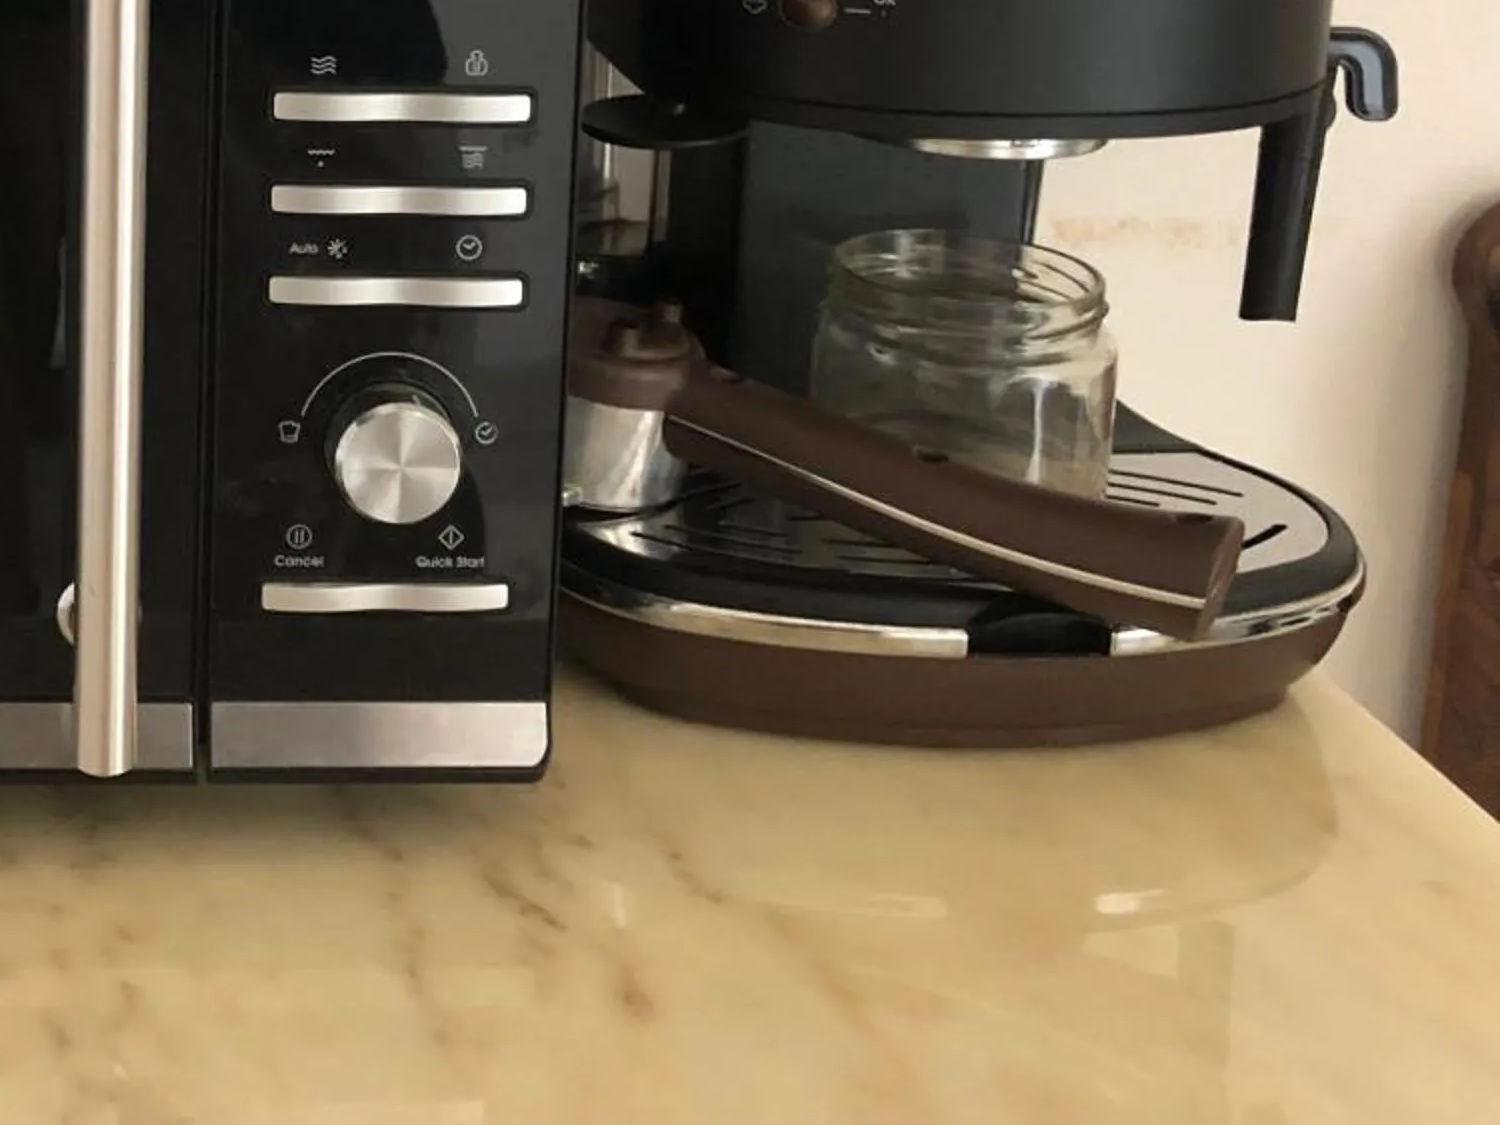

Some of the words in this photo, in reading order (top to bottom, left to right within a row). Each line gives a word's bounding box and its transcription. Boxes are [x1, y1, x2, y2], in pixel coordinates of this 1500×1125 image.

[288, 242, 319, 254] Auto
[274, 555, 325, 567] Cancel
[415, 556, 453, 568] Quick
[456, 556, 485, 568] Start
